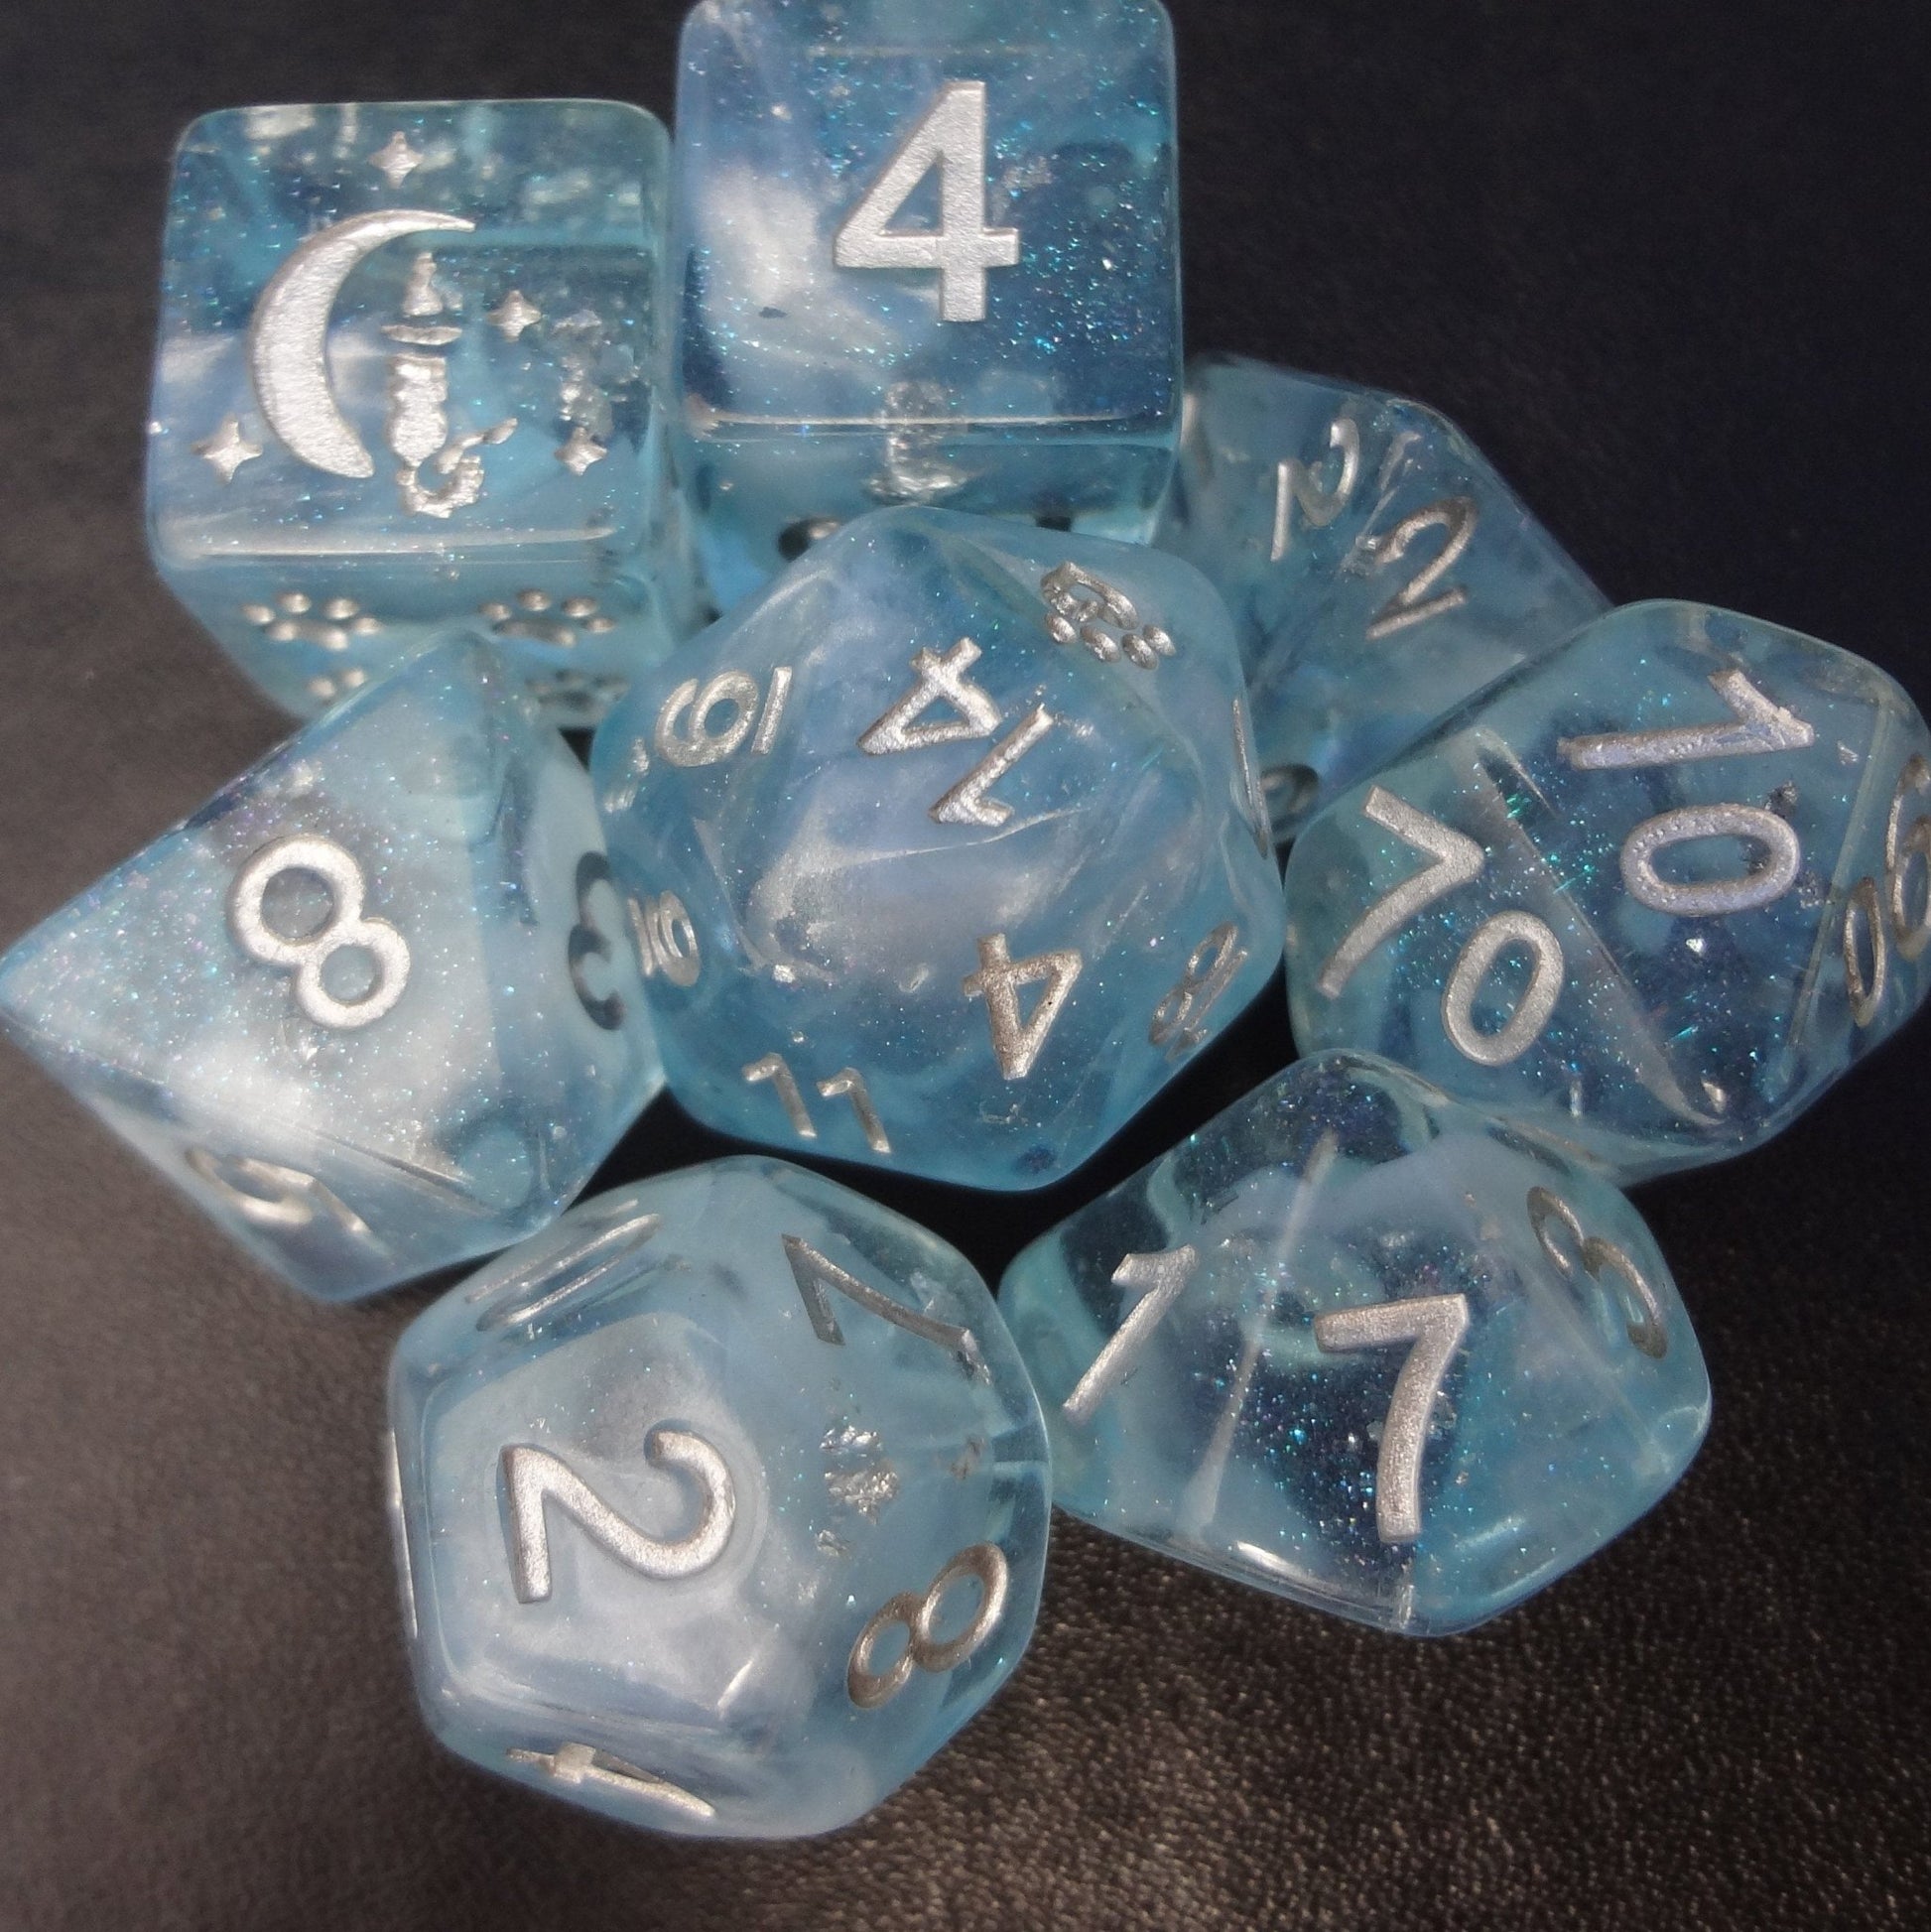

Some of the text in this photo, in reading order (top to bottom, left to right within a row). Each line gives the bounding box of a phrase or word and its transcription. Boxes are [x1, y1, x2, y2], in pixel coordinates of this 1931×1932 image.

[834, 80, 1019, 322] 4
[1365, 495, 1477, 640] 2
[1556, 670, 1816, 918] 10
[228, 834, 411, 1029] 8
[963, 933, 1084, 1080] 4
[1318, 786, 1565, 1066] 70
[1063, 1244, 1195, 1423] 1
[1314, 1292, 1469, 1542] 7
[501, 1429, 735, 1604] 2
[848, 1543, 1009, 1709] 8
